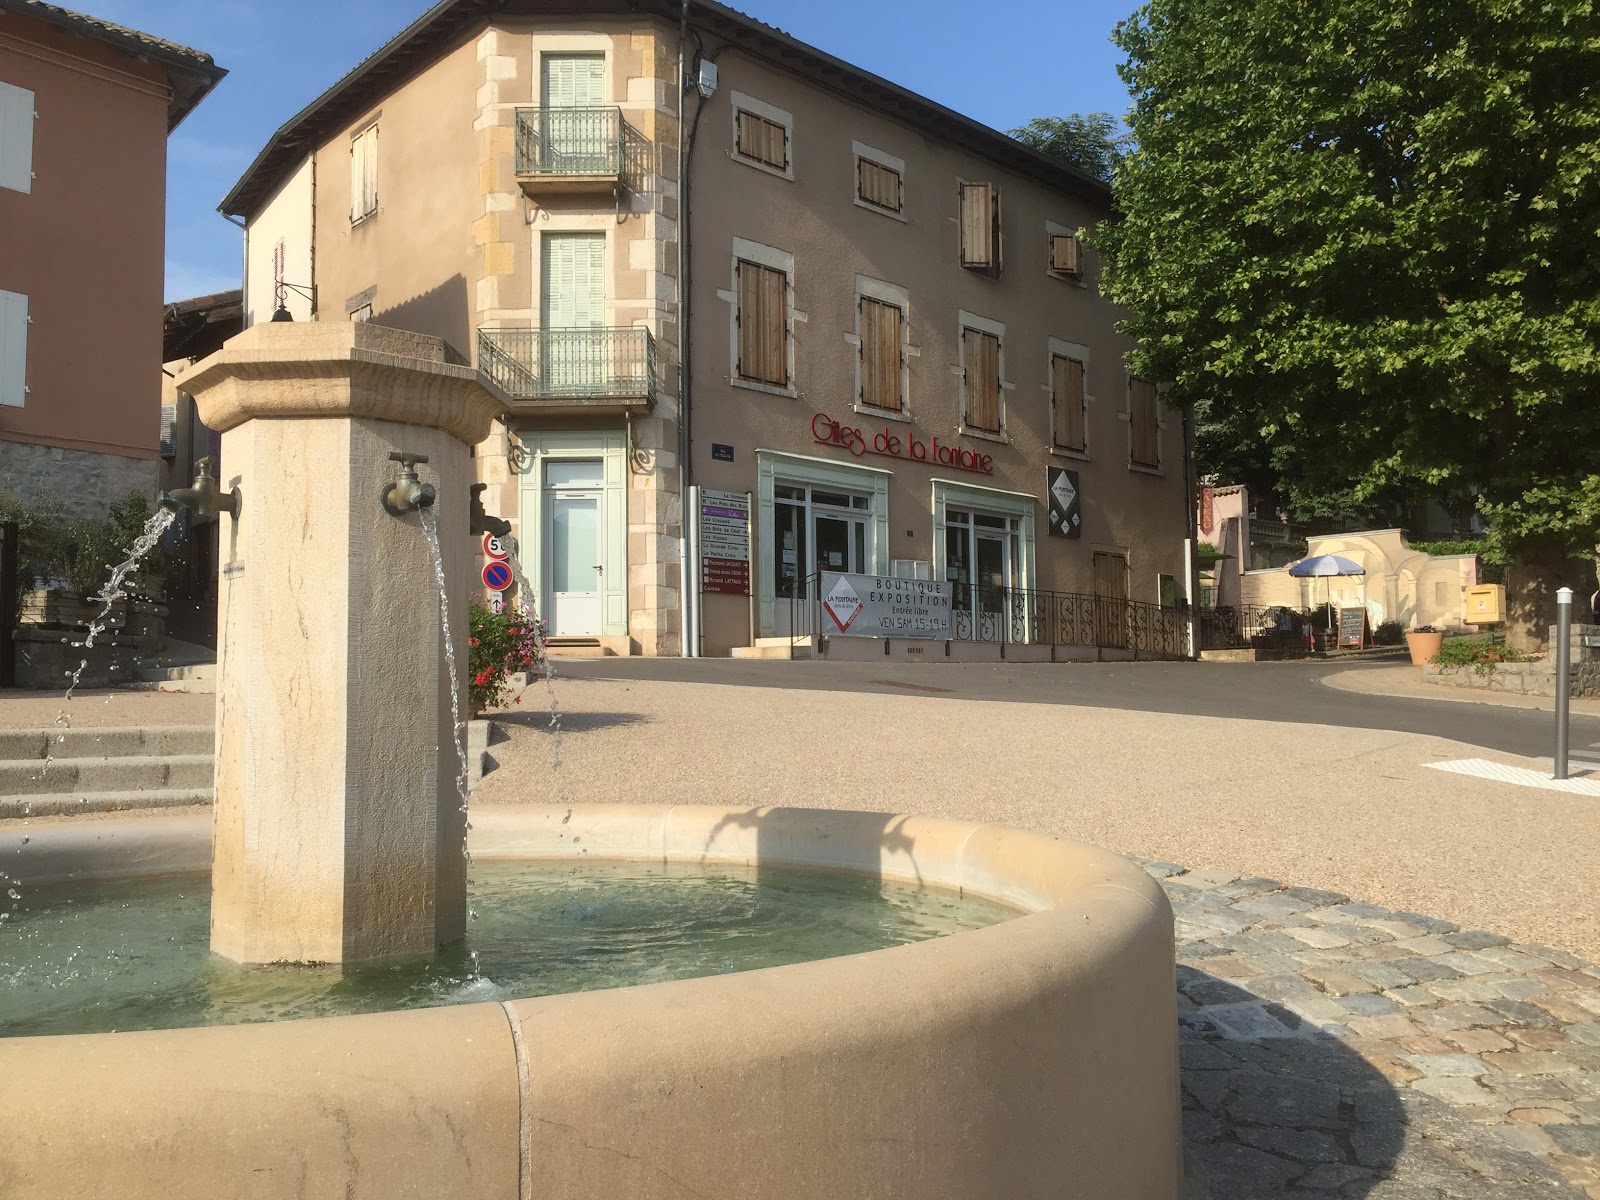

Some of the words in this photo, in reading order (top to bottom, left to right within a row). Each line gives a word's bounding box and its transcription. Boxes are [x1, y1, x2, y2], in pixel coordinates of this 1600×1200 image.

[872, 427, 901, 454] de
[908, 432, 926, 459] la
[931, 436, 994, 471] Fontaine
[1203, 488, 1212, 529] CAVEAU
[491, 540, 505, 551] 5
[876, 579, 941, 595] BOUTIQUE
[835, 596, 859, 604] FONTAINE
[870, 592, 948, 606] EXPOSITION
[892, 606, 912, 615] Entrée
[914, 606, 929, 616] libre
[879, 617, 895, 628] VEN
[897, 618, 912, 629] SAM
